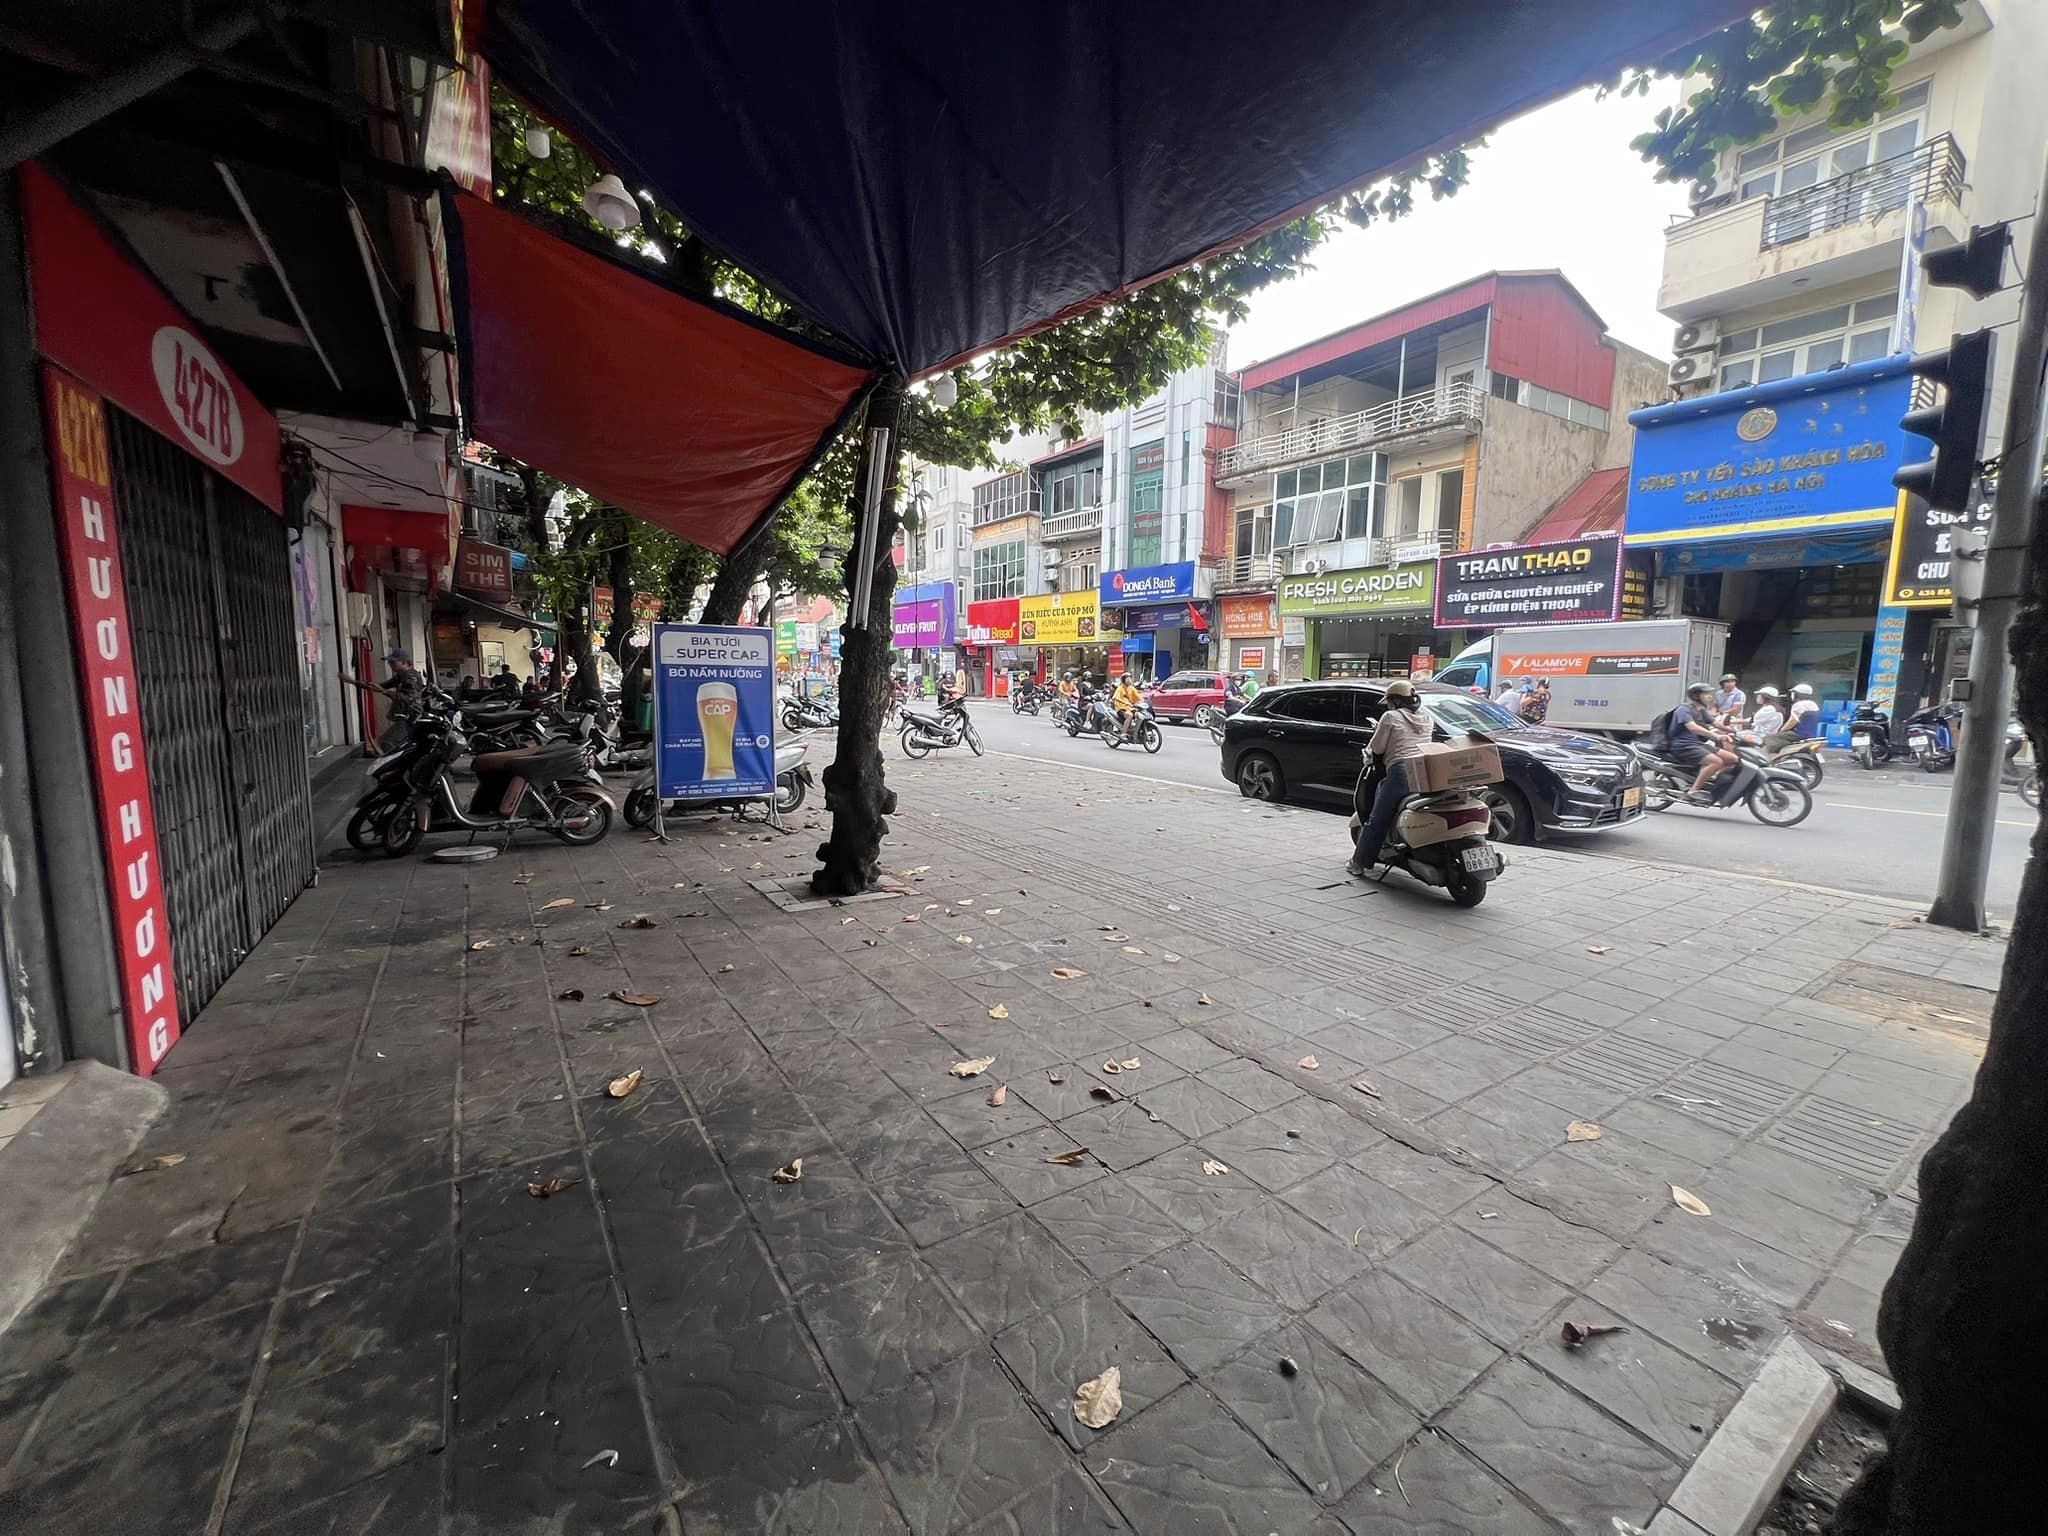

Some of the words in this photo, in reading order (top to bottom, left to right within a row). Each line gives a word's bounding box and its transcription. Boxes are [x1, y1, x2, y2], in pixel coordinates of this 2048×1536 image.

[174, 341, 233, 458] 427B
[1680, 470, 1700, 487] TY
[466, 553, 504, 568] SIM
[1153, 576, 1176, 590] Bank
[1283, 580, 1337, 599] FRESH
[1341, 571, 1423, 594] GARDEN
[1446, 589, 1469, 603] SỬA
[1471, 587, 1501, 601] CHỮA
[1503, 585, 1552, 599] CHUYÊN
[1553, 581, 1605, 597] NGHIỆP
[919, 621, 937, 632] FRUIT
[966, 624, 990, 640] Tuhu
[991, 626, 1013, 639] Bread
[691, 637, 711, 646] BIA
[677, 648, 727, 659] SUPER
[731, 650, 759, 660] CAP
[1523, 658, 1583, 668] LALAMOVE
[669, 667, 687, 677] BÒ
[704, 704, 731, 716] CAP
